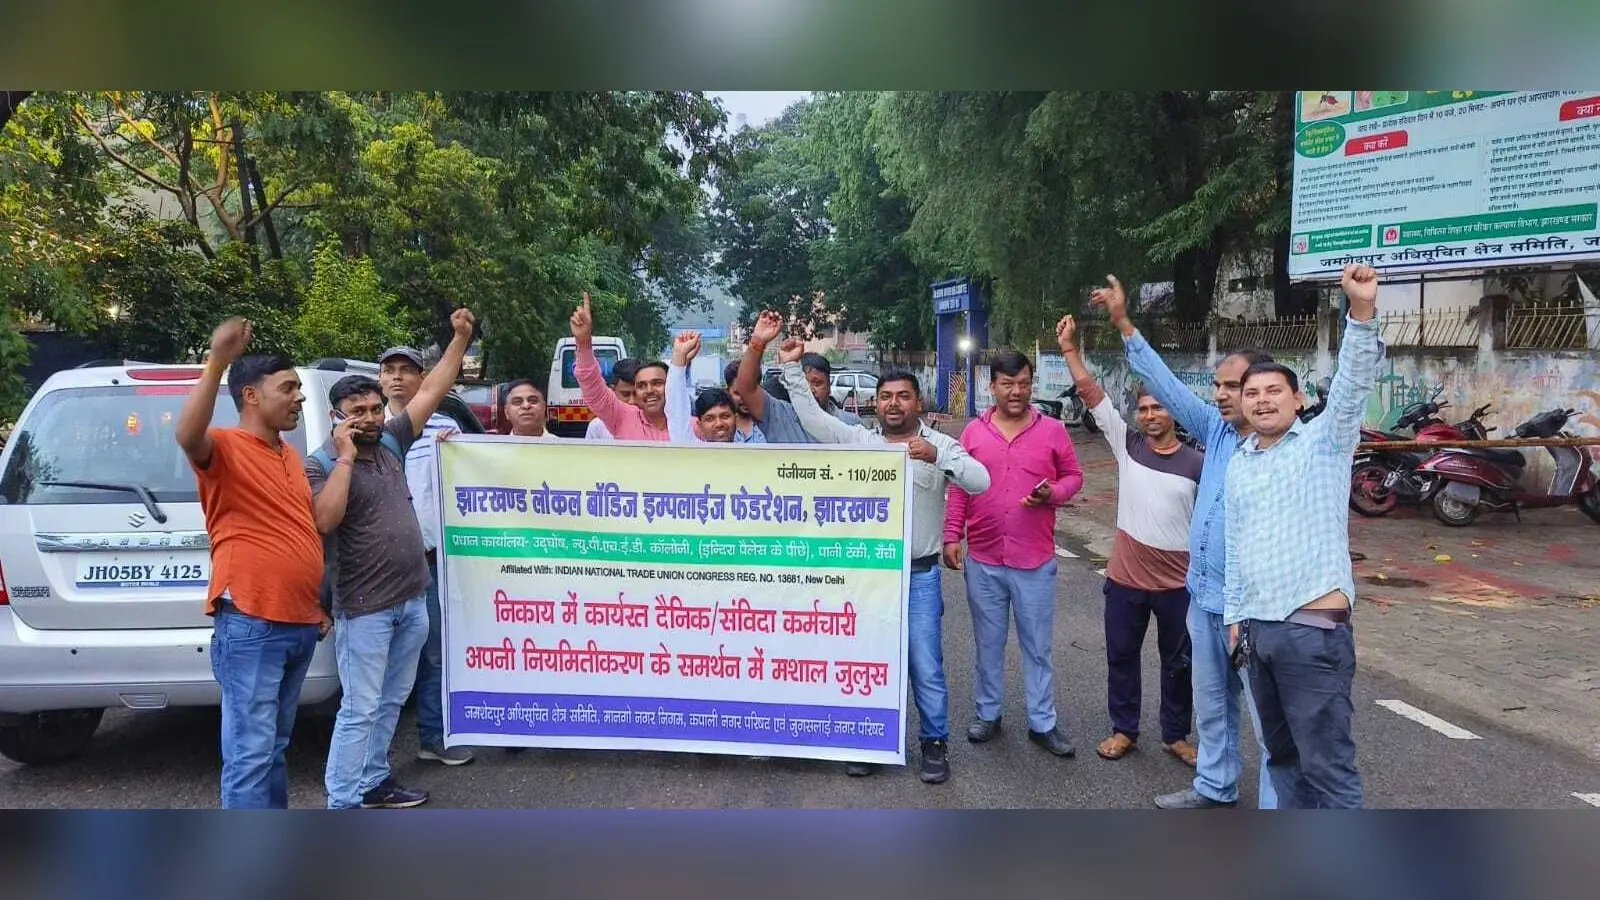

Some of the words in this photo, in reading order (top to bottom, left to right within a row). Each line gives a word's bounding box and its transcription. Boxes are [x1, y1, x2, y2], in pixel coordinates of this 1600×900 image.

[1391, 245, 1467, 264] अधिसूचित
[1473, 242, 1504, 255] क्षेत्र
[1509, 236, 1575, 252] समिति,
[776, 463, 816, 481] पंजीयन
[819, 464, 834, 481] सं.
[847, 467, 897, 482] 110/2005
[454, 486, 527, 517] झारखण्ड
[530, 480, 582, 517] लोकल
[586, 482, 639, 518] बॉडिज
[642, 483, 726, 525] इम्पलाईज
[730, 485, 808, 524] फेडरेशन,
[813, 495, 890, 527] झारखण्ड
[451, 534, 479, 547] प्रधान
[481, 531, 529, 549] कार्यालय-
[650, 538, 693, 557] कॉलोनी,
[739, 539, 767, 556] पैलेस
[770, 541, 782, 556] के
[818, 543, 842, 559] पानी
[83, 564, 155, 581] JH05BY
[160, 564, 202, 580] 4125
[500, 564, 533, 575] Affiliated
[533, 564, 553, 575] With:
[555, 566, 584, 576] INDIAN
[585, 567, 626, 578] NATIONAL
[627, 569, 655, 579] TRADE
[657, 570, 685, 580] UNION
[686, 571, 735, 582] CONGRESS
[760, 574, 775, 583] NO.
[805, 575, 823, 584] New
[825, 576, 845, 585] Delhi
[493, 588, 555, 624] निकाय
[561, 590, 579, 625] में
[583, 591, 649, 628] कार्यरत
[655, 594, 777, 636] दैनिक/संविदा
[781, 599, 857, 637] कर्मचारी
[465, 636, 516, 671] अपनी
[521, 638, 645, 675] नियमितीकरण
[649, 642, 671, 676] के
[676, 643, 742, 680] समर्थन
[747, 646, 765, 681] में
[771, 657, 828, 684] मशाल
[834, 660, 889, 696] जुलुस
[464, 700, 505, 726] जमशेदपुर
[507, 702, 549, 729] अधिसूचित
[551, 702, 568, 723] क्षेत्र
[569, 703, 600, 725] समिति,
[602, 705, 632, 724] मानगो
[634, 710, 656, 725] नगर
[657, 706, 687, 727] निगम,
[689, 708, 718, 728] कपाली
[721, 713, 742, 729] नगर
[744, 710, 771, 732] परिषद
[773, 712, 786, 733] एवं
[789, 713, 832, 738] जुगसलाई
[834, 719, 856, 735] नगर
[857, 716, 885, 737] परिषद
